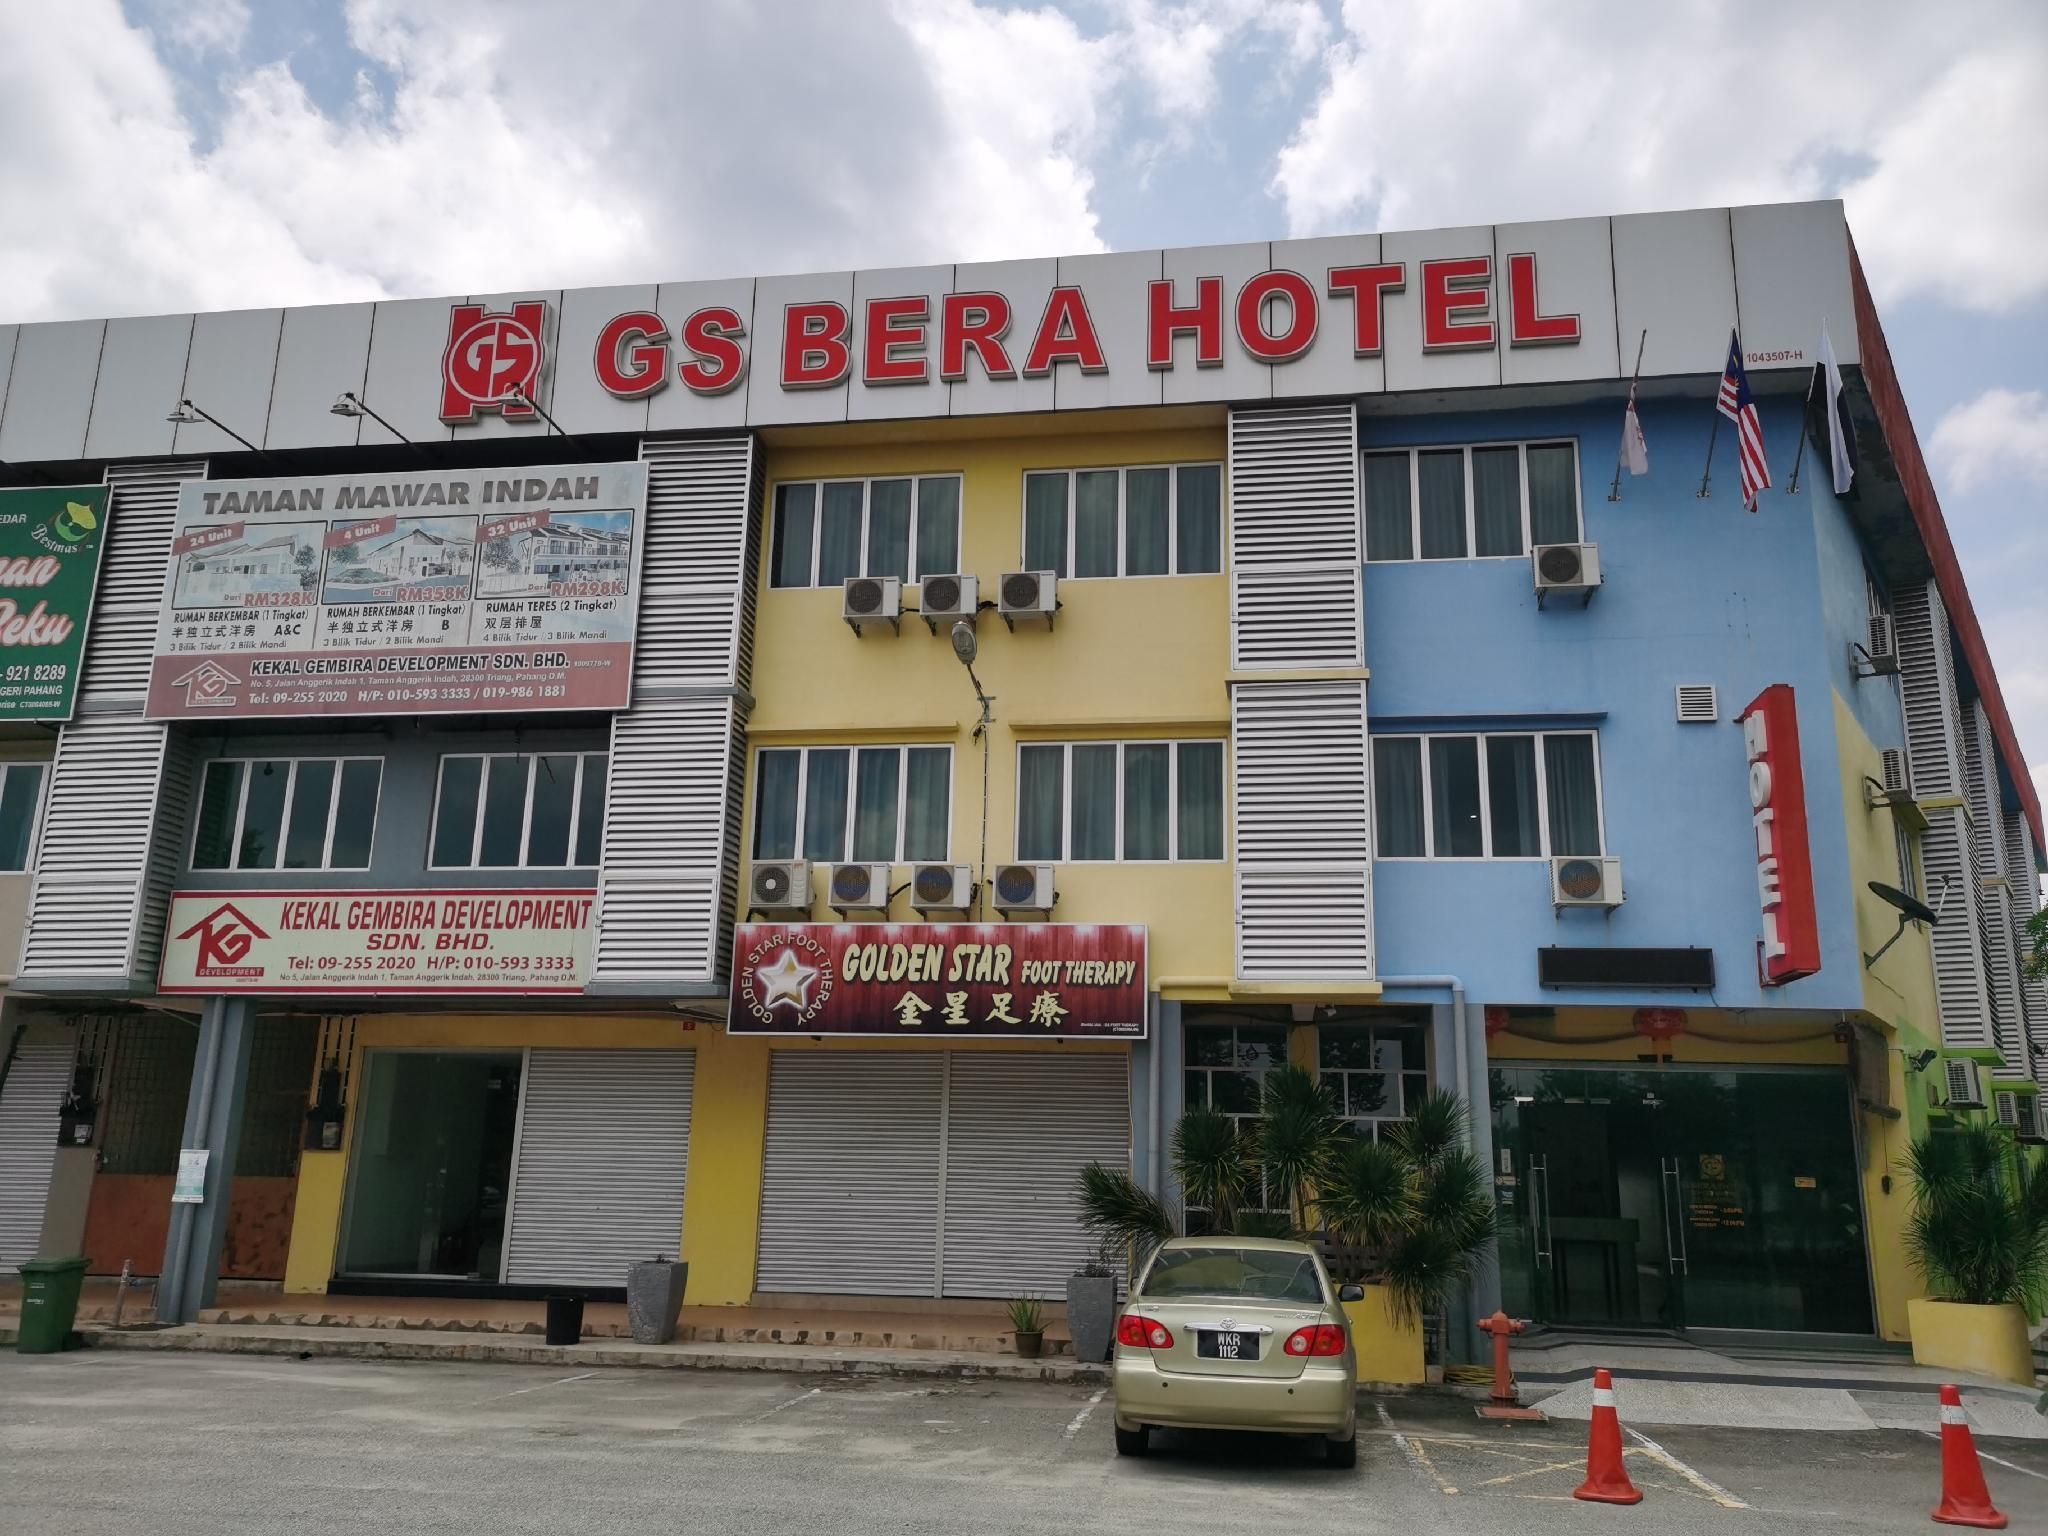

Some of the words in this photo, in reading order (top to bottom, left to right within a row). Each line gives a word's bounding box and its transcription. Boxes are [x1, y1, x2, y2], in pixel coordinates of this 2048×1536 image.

[594, 307, 746, 400] GS
[780, 285, 1109, 391] BERA
[1147, 253, 1581, 371] HOTEL
[1747, 351, 1803, 362] 1043507-H
[203, 488, 324, 515] TAMAN
[334, 482, 470, 510] MAWAR
[482, 477, 599, 503] INDAH
[344, 531, 352, 539] 4
[355, 524, 381, 537] Unit
[488, 525, 505, 536] 32
[509, 516, 537, 531] Unit
[190, 534, 206, 547] 24
[208, 530, 233, 542] Unit
[396, 587, 467, 600] RM358K
[528, 584, 547, 592] Dari
[551, 581, 624, 596] RM298K
[224, 593, 241, 601] Dari
[244, 592, 313, 606] RM328K
[486, 601, 523, 612] RUMAH
[528, 601, 556, 612] TERES
[560, 600, 570, 611] (2
[574, 599, 617, 612] Tingkat)
[174, 611, 205, 623] RUMAH
[208, 610, 259, 622] BERKEMBAR
[262, 610, 270, 621] (1
[272, 609, 309, 622] Tingkat)
[327, 606, 360, 618] RUMAH
[362, 605, 415, 617] BERKEMBAR
[418, 605, 425, 616] (1
[428, 604, 465, 616] Tingkat)
[327, 620, 413, 633] 半独立式洋房
[441, 620, 450, 631] B
[485, 616, 542, 629] 双层排屋
[172, 625, 256, 638] 半独立式洋房
[274, 624, 301, 636] A&C
[492, 633, 511, 641] Bilik
[516, 633, 537, 641] Tidur
[547, 632, 553, 640] 3
[556, 631, 575, 639] Bilik
[579, 630, 607, 639] Mandi
[178, 643, 196, 651] Bilik
[200, 642, 221, 650] Tidur
[238, 641, 257, 649] Bilik
[260, 641, 287, 649] Mandi
[332, 638, 350, 646] Bilik
[355, 637, 376, 645] Tidur
[394, 636, 413, 644] Bilik
[416, 635, 444, 643] Mandi
[251, 660, 300, 675] KEKAL
[305, 659, 373, 673] GEMBIRA
[377, 656, 489, 672] DEVELOPMENT
[493, 654, 529, 669] SDN.
[534, 653, 570, 667] BHD.
[6, 666, 30, 680] 921
[34, 665, 67, 680] 8289
[274, 679, 296, 687] Jalan
[298, 678, 333, 688] Anggerik
[335, 677, 357, 686] Indah
[368, 677, 394, 685] Taman
[396, 675, 432, 686] Anggerik
[434, 674, 459, 683] Indah,
[460, 674, 484, 682] 28300
[487, 673, 514, 682] Triang,
[516, 673, 547, 682] Pahang
[24, 686, 62, 695] PAHANG
[249, 693, 270, 704] Tel:
[273, 692, 314, 703] 09-255
[318, 691, 348, 702] 2020
[358, 690, 384, 702] H/P:
[387, 689, 437, 701] 010-593
[440, 687, 470, 699] 3333
[482, 686, 533, 698] 019-986
[538, 685, 566, 697] 1881
[1744, 709, 1785, 958] HOTEL
[280, 902, 341, 930] KEKAL
[347, 901, 436, 930] GEMBIRA
[441, 900, 592, 929] DEVELOPMENT
[367, 934, 425, 950] SDN.
[435, 933, 494, 950] BHD.
[787, 932, 825, 958] FOOT
[748, 934, 784, 964] STAR
[288, 957, 313, 969] Tel:
[318, 957, 372, 970] 09-255
[376, 957, 416, 969] 2020
[427, 957, 460, 969] H/P:
[464, 956, 530, 969] 010-593
[534, 956, 574, 969] 3333
[842, 943, 944, 982] GOLDEN
[948, 943, 1012, 986] STAR
[1021, 960, 1062, 984] FOOT
[1065, 960, 1136, 986] THERAPY
[199, 968, 263, 976] DEVELOPMENT
[322, 974, 356, 983] Anggerik
[415, 974, 450, 983] Anggerik
[451, 974, 475, 982] Indah,
[502, 974, 527, 983] Triang,
[530, 974, 559, 983] Pahang
[741, 967, 773, 1024] GOLDEN
[796, 958, 833, 1026] THERAPY
[893, 990, 1069, 1027] 金星足療
[1217, 1332, 1240, 1346] WKR
[1219, 1346, 1239, 1358] 1112
